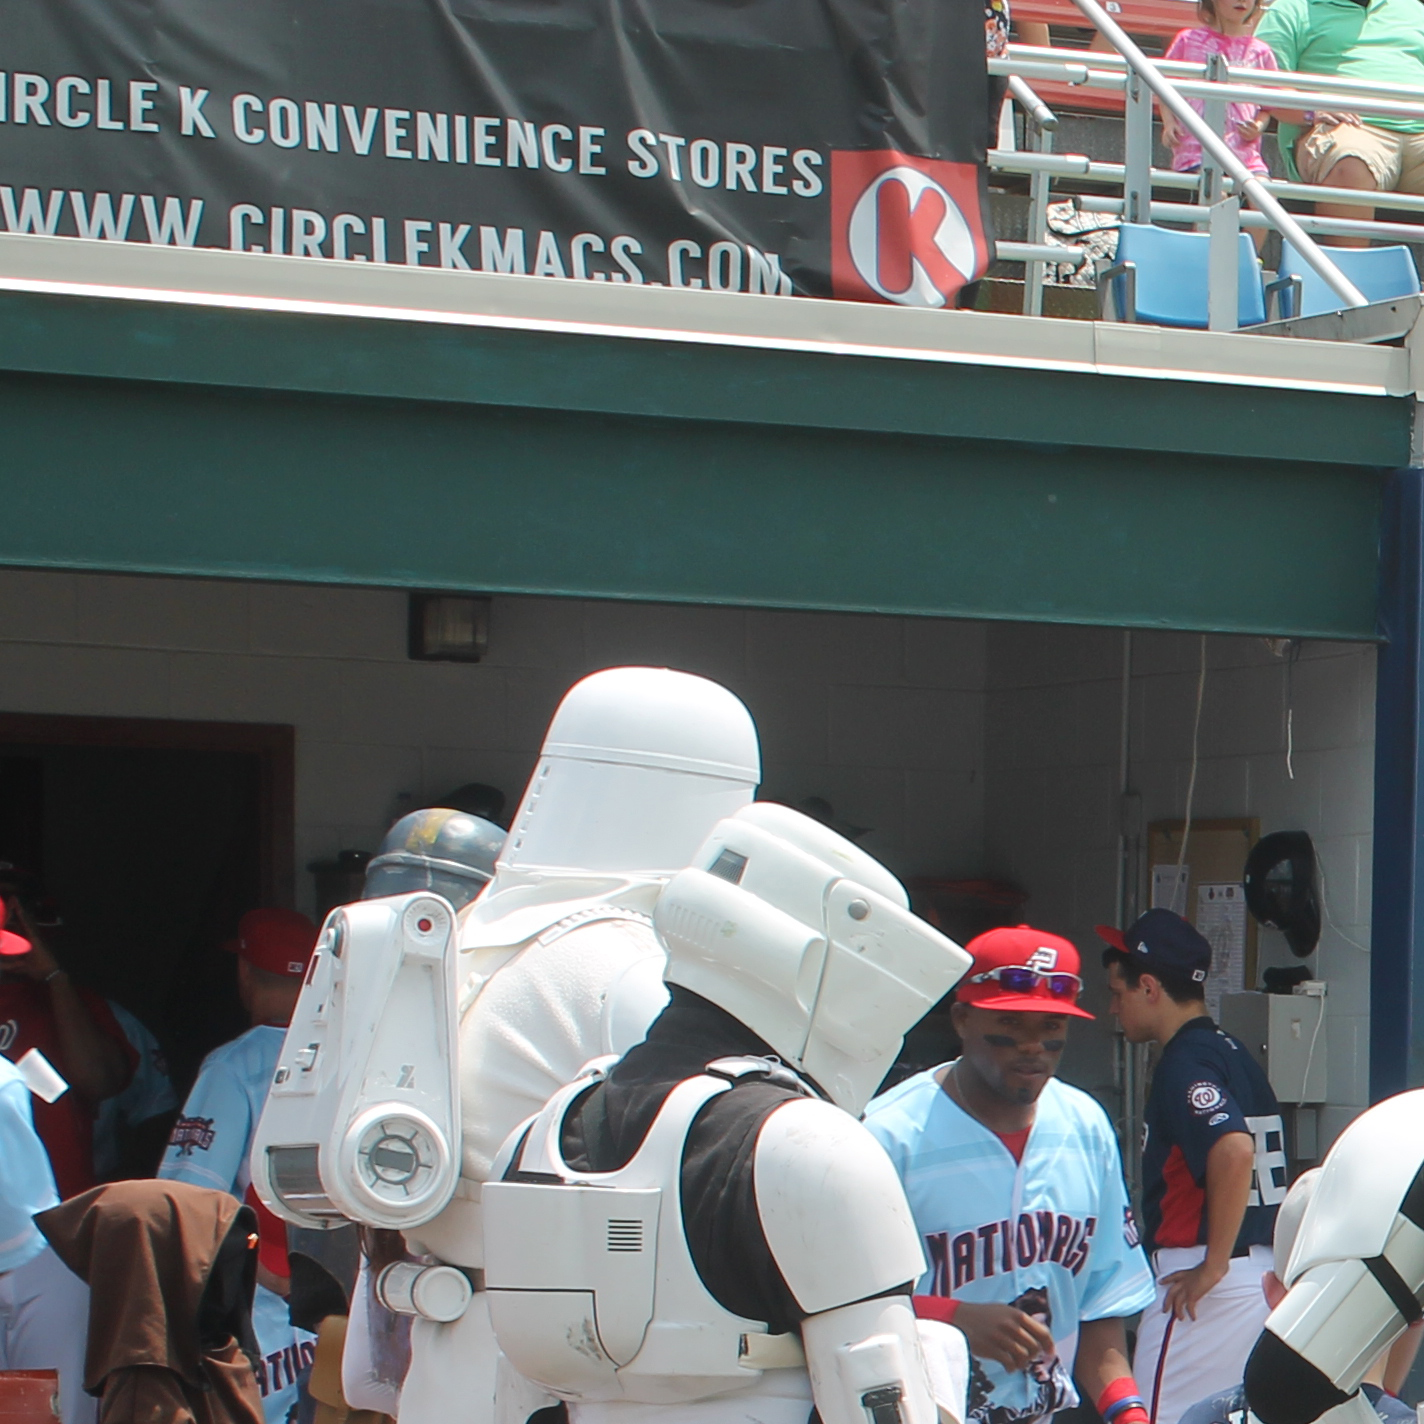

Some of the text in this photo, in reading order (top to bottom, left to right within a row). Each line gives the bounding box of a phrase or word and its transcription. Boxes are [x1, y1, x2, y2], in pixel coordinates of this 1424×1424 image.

[178, 86, 216, 138] K
[231, 93, 606, 176] CONVENIENCE
[627, 128, 823, 198] STORES
[925, 1210, 1097, 1297] NATIONALS
